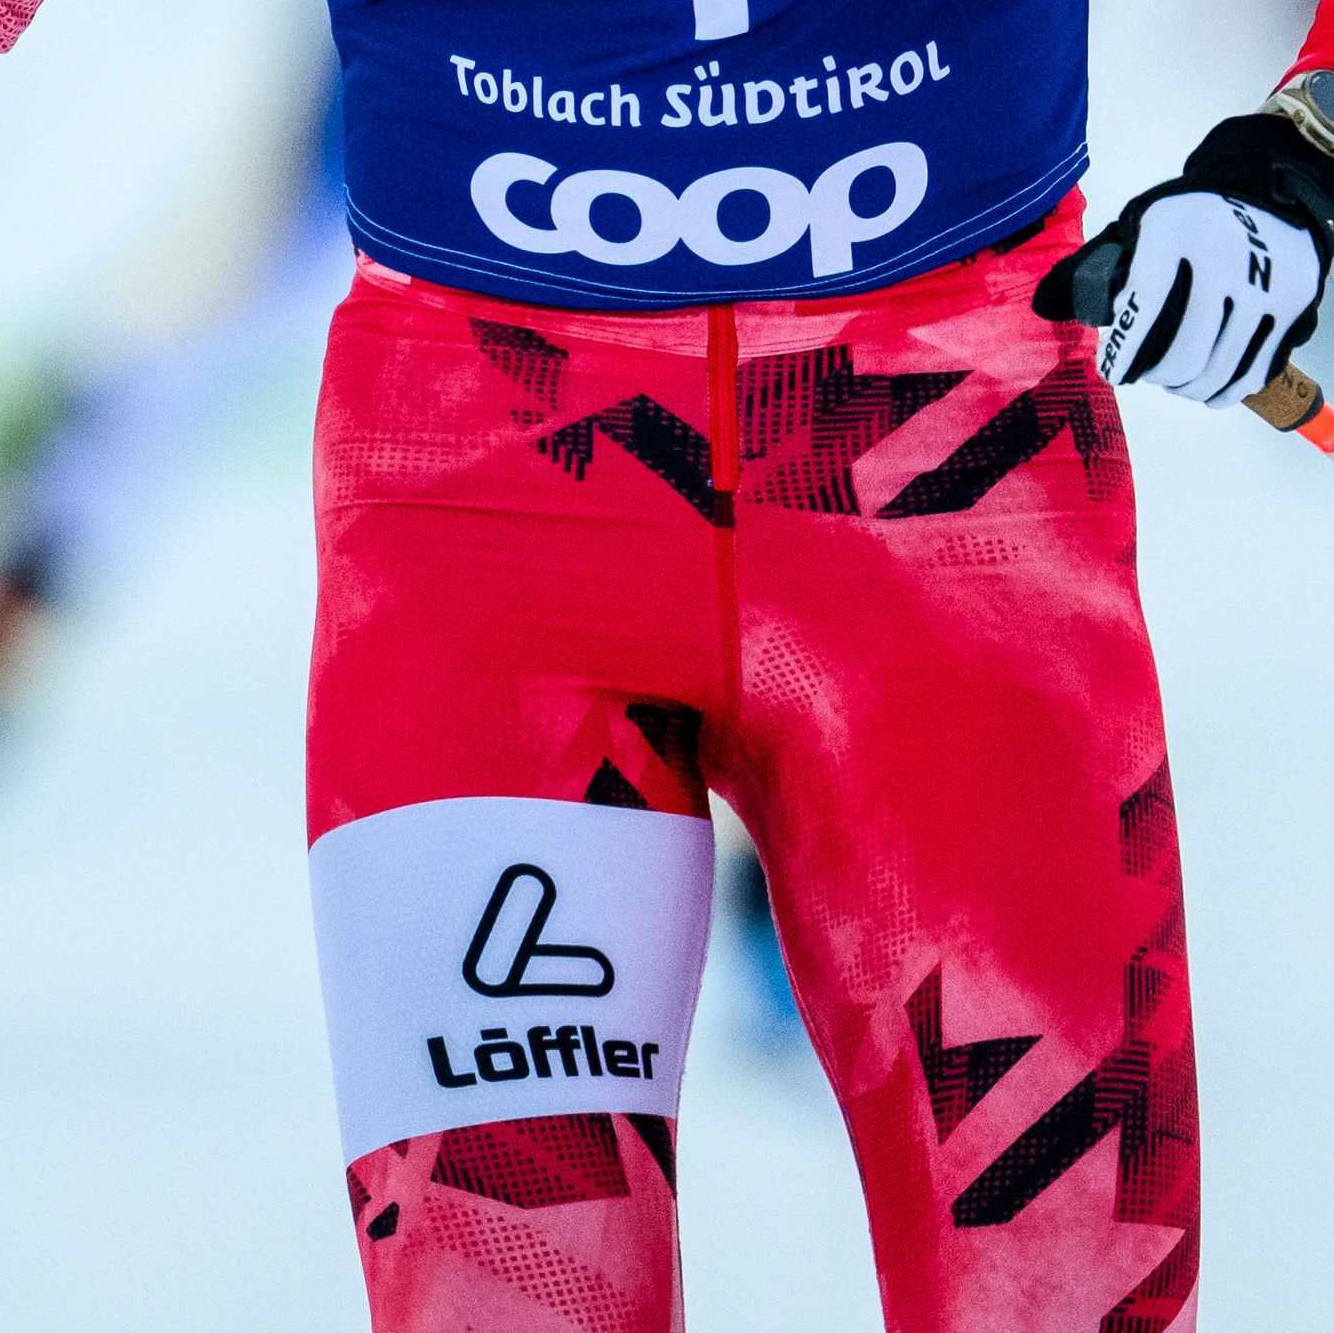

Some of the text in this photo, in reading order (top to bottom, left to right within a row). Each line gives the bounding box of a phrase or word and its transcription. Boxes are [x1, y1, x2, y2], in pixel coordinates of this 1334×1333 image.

[450, 53, 641, 127] Toblach
[470, 141, 928, 278] coop
[426, 1024, 659, 1088] Löffler
